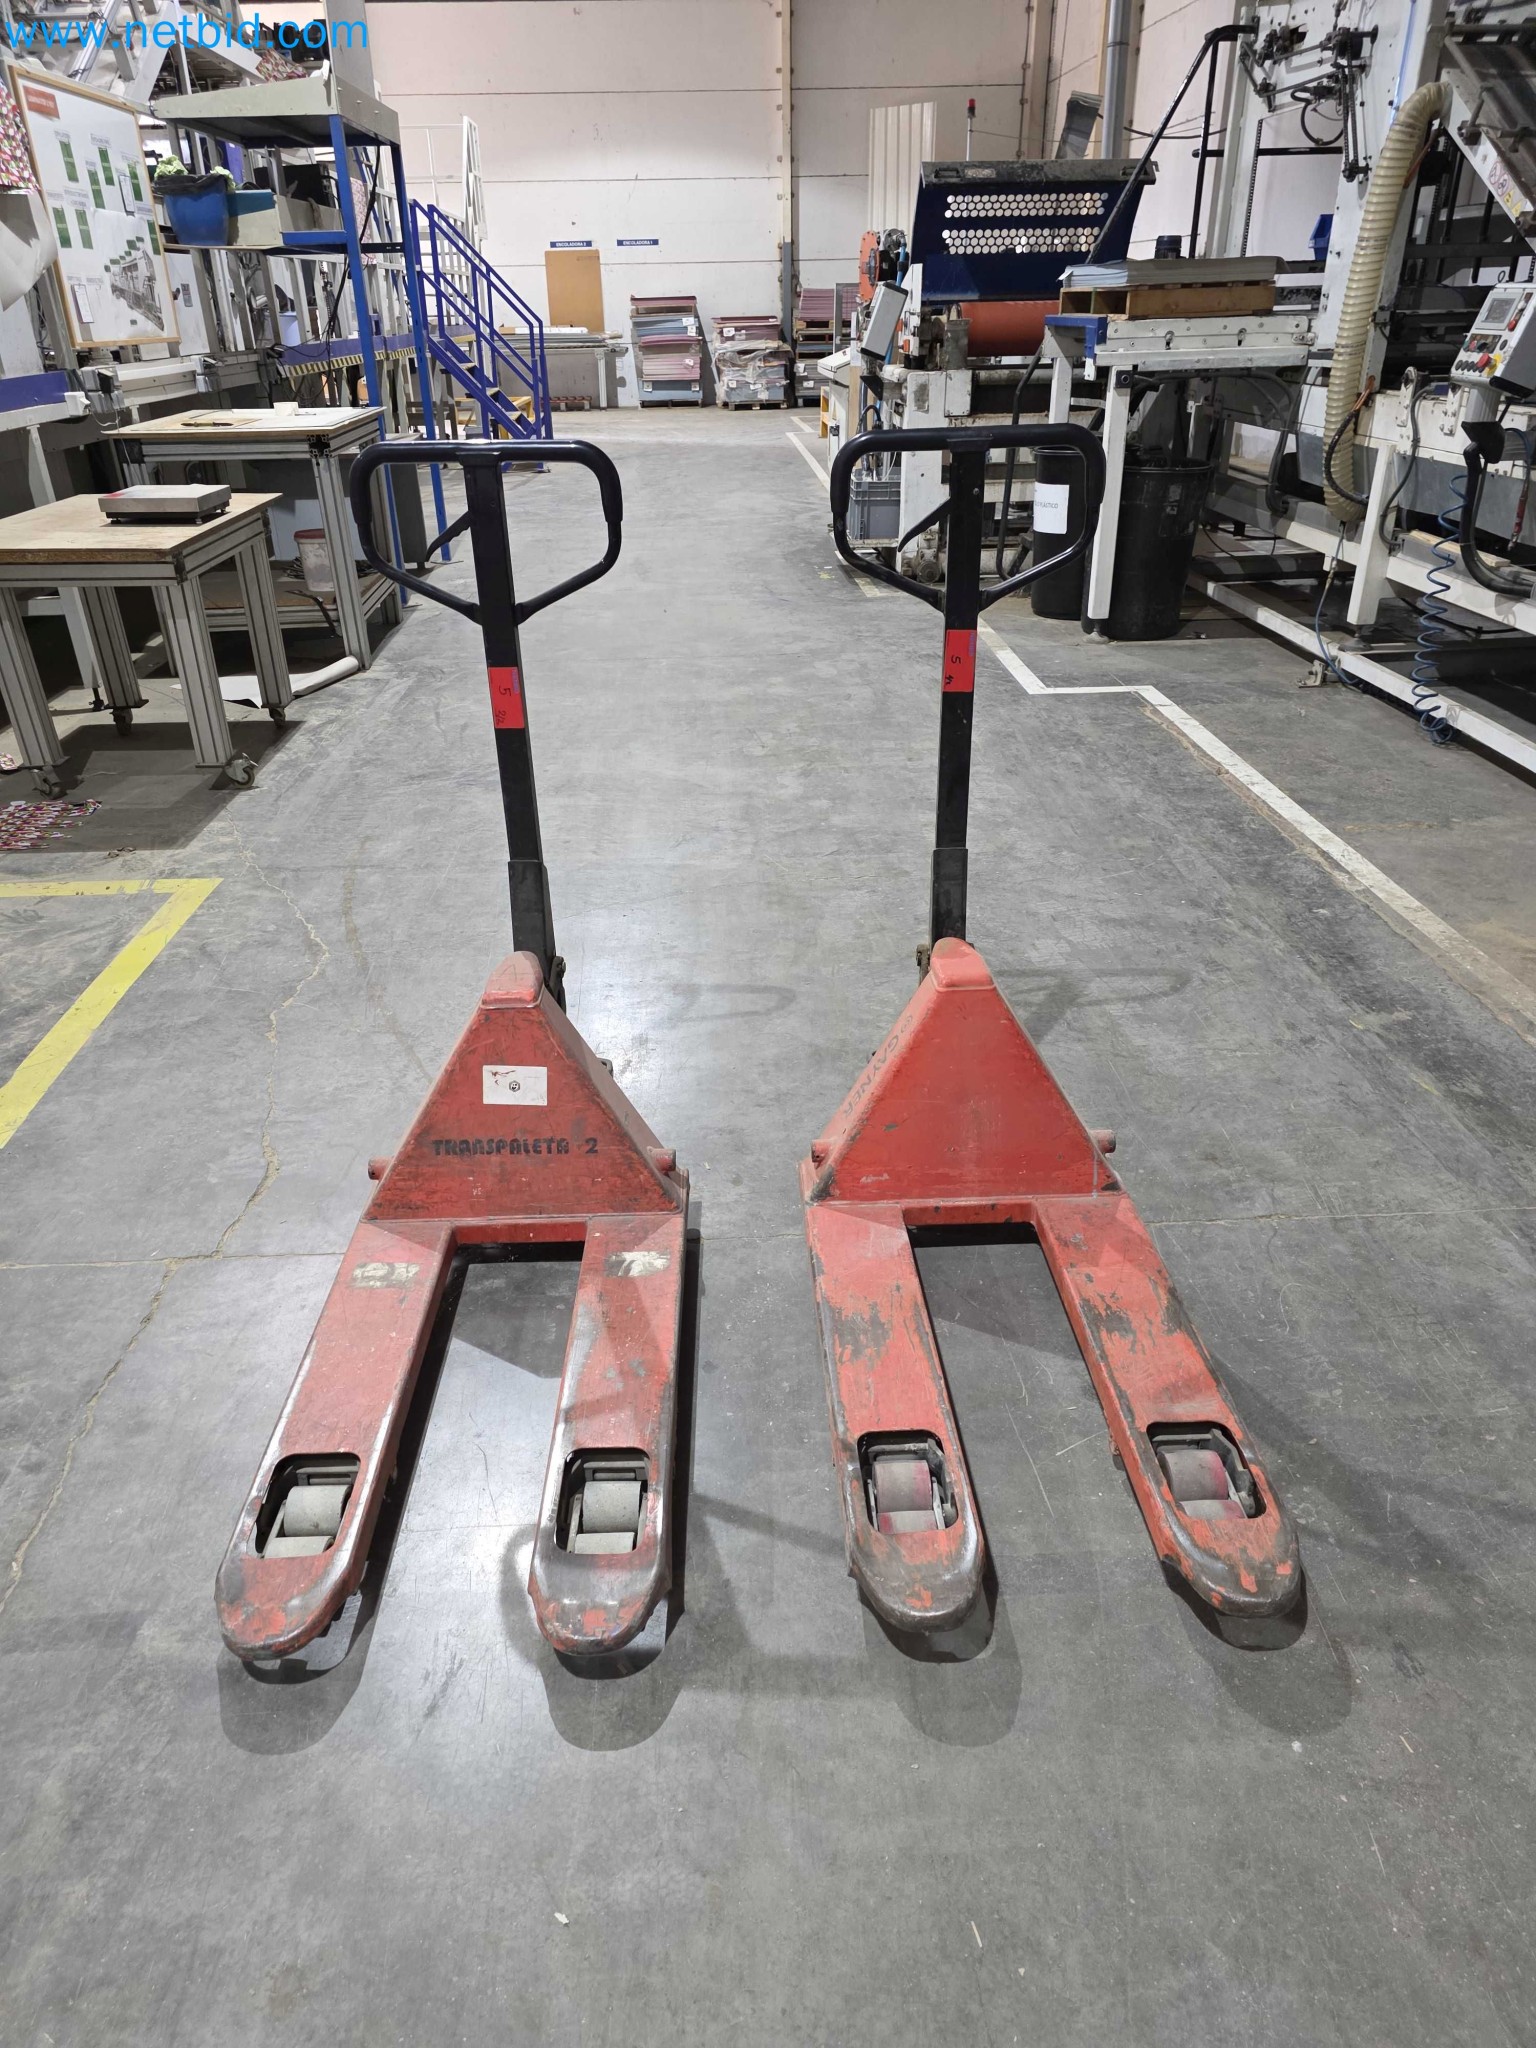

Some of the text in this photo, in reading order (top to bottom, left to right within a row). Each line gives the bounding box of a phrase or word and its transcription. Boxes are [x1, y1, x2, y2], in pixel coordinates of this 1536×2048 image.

[499, 685, 512, 697] 5
[844, 1034, 899, 1116] GAYNER
[432, 1136, 599, 1156] TRANSPALETA 2
